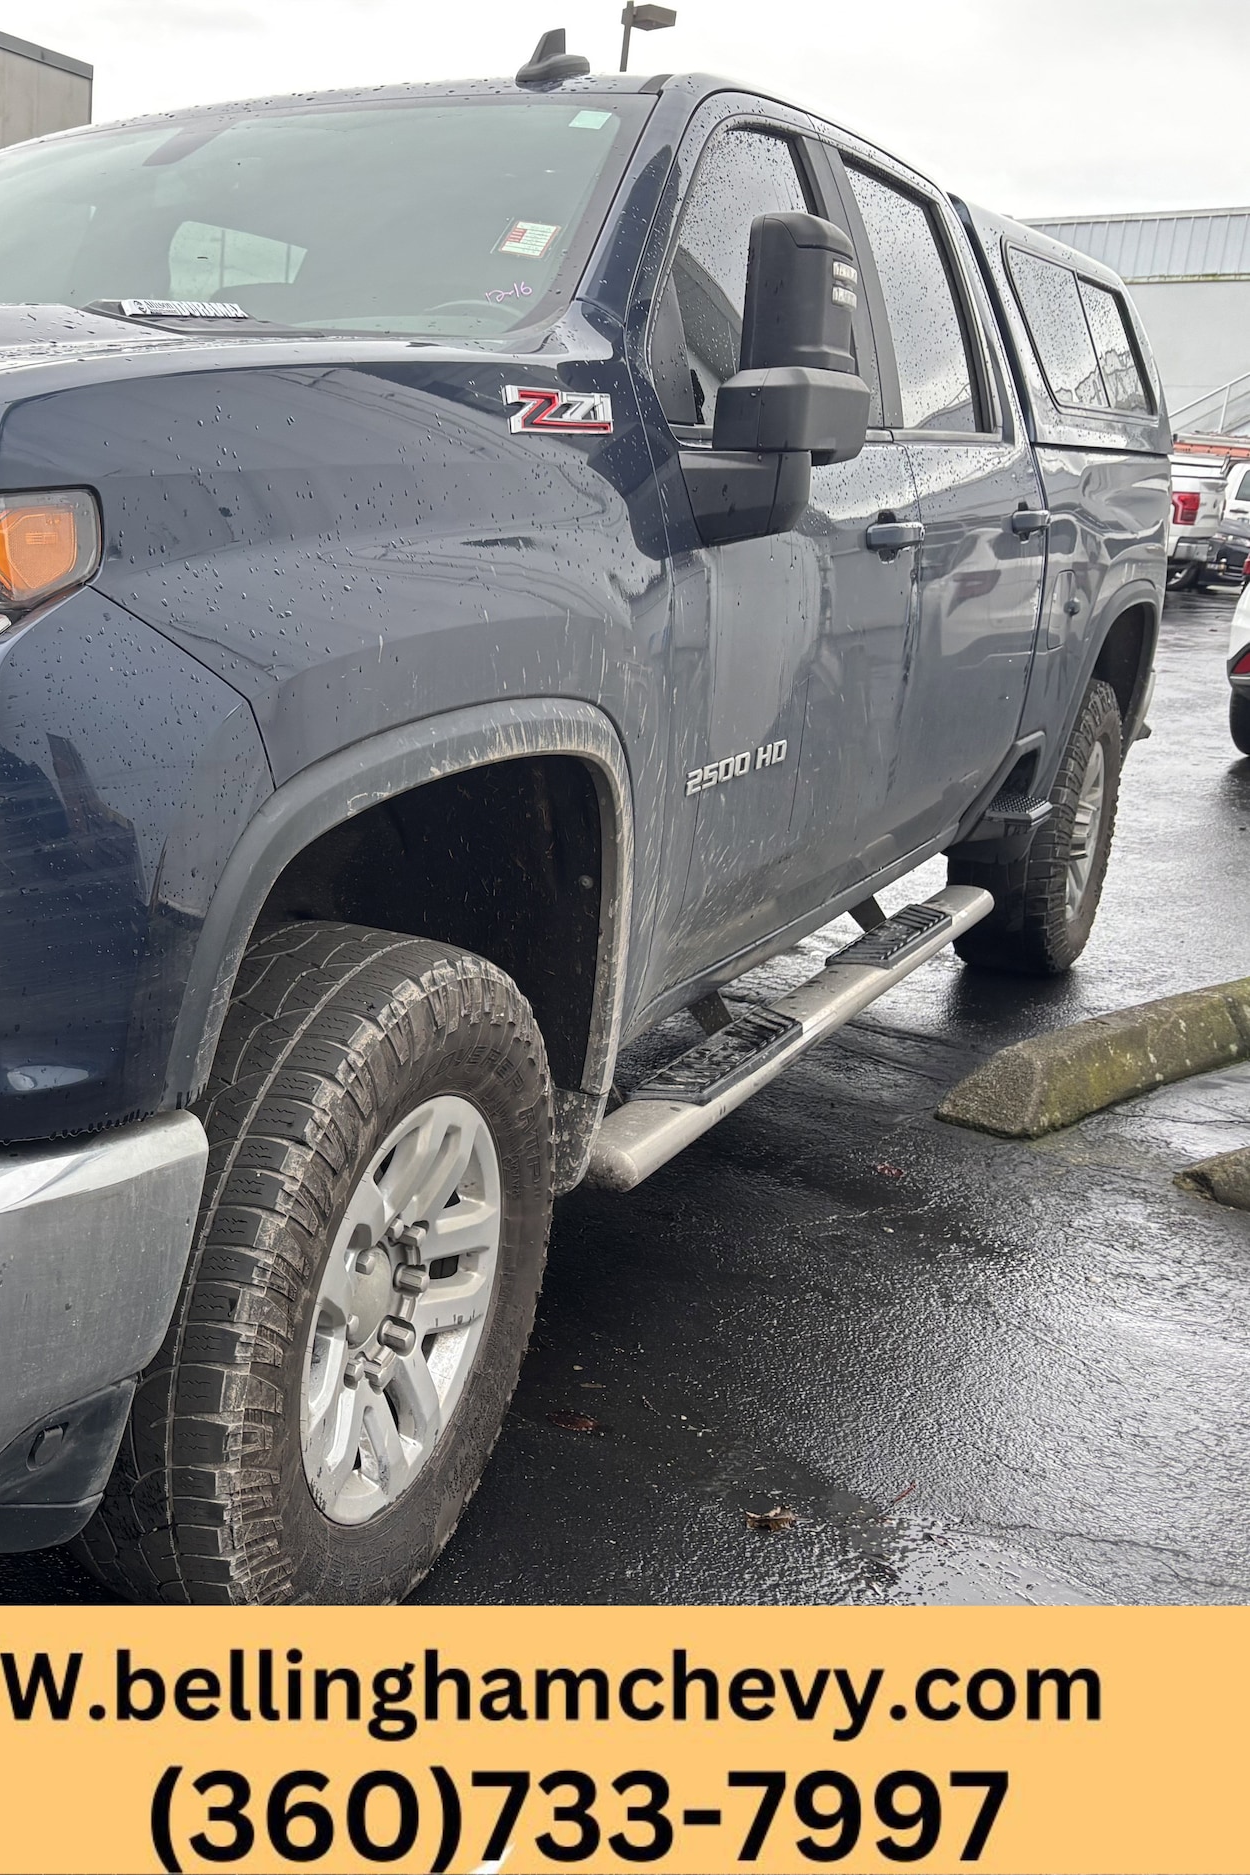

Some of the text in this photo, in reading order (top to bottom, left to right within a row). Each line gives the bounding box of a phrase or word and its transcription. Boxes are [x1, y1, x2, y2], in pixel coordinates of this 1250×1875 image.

[485, 281, 533, 302] 12-16
[172, 301, 249, 318] DURAMAX
[502, 385, 614, 433] Z71
[685, 739, 788, 797] 2500 HD
